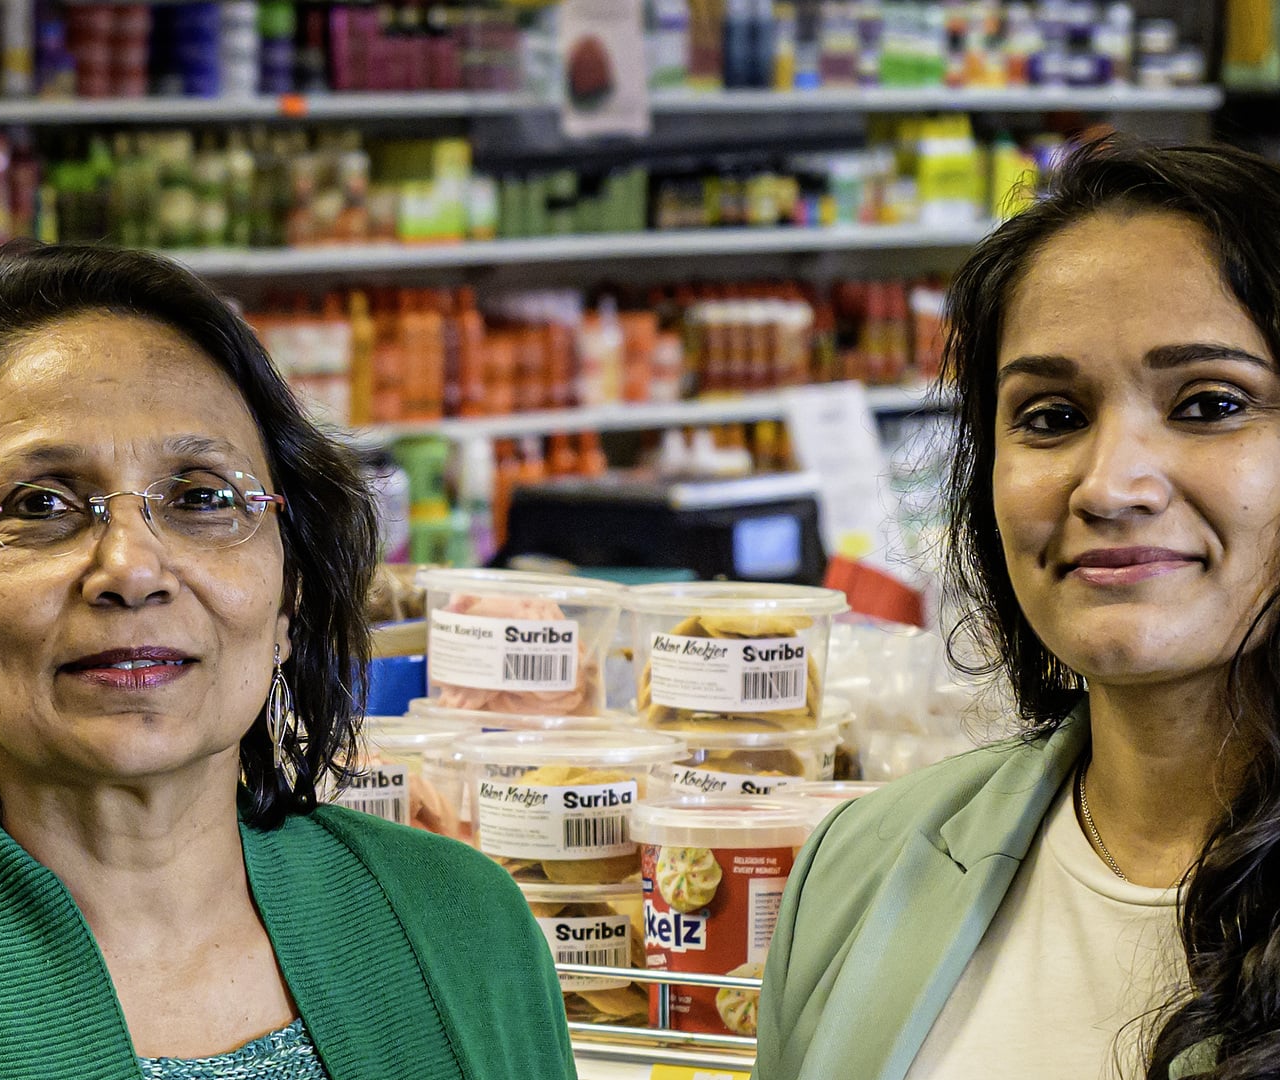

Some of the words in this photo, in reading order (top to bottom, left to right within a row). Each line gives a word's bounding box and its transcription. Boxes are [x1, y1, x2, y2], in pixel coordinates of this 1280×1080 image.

[505, 626, 573, 644] Suriba
[683, 640, 728, 660] Koekjes
[743, 644, 804, 662] Suriba
[348, 770, 404, 788] uriba
[681, 771, 726, 793] Koekjes
[563, 790, 632, 808] Suriba
[556, 924, 626, 941] Suriba
[645, 905, 701, 947] kelz
